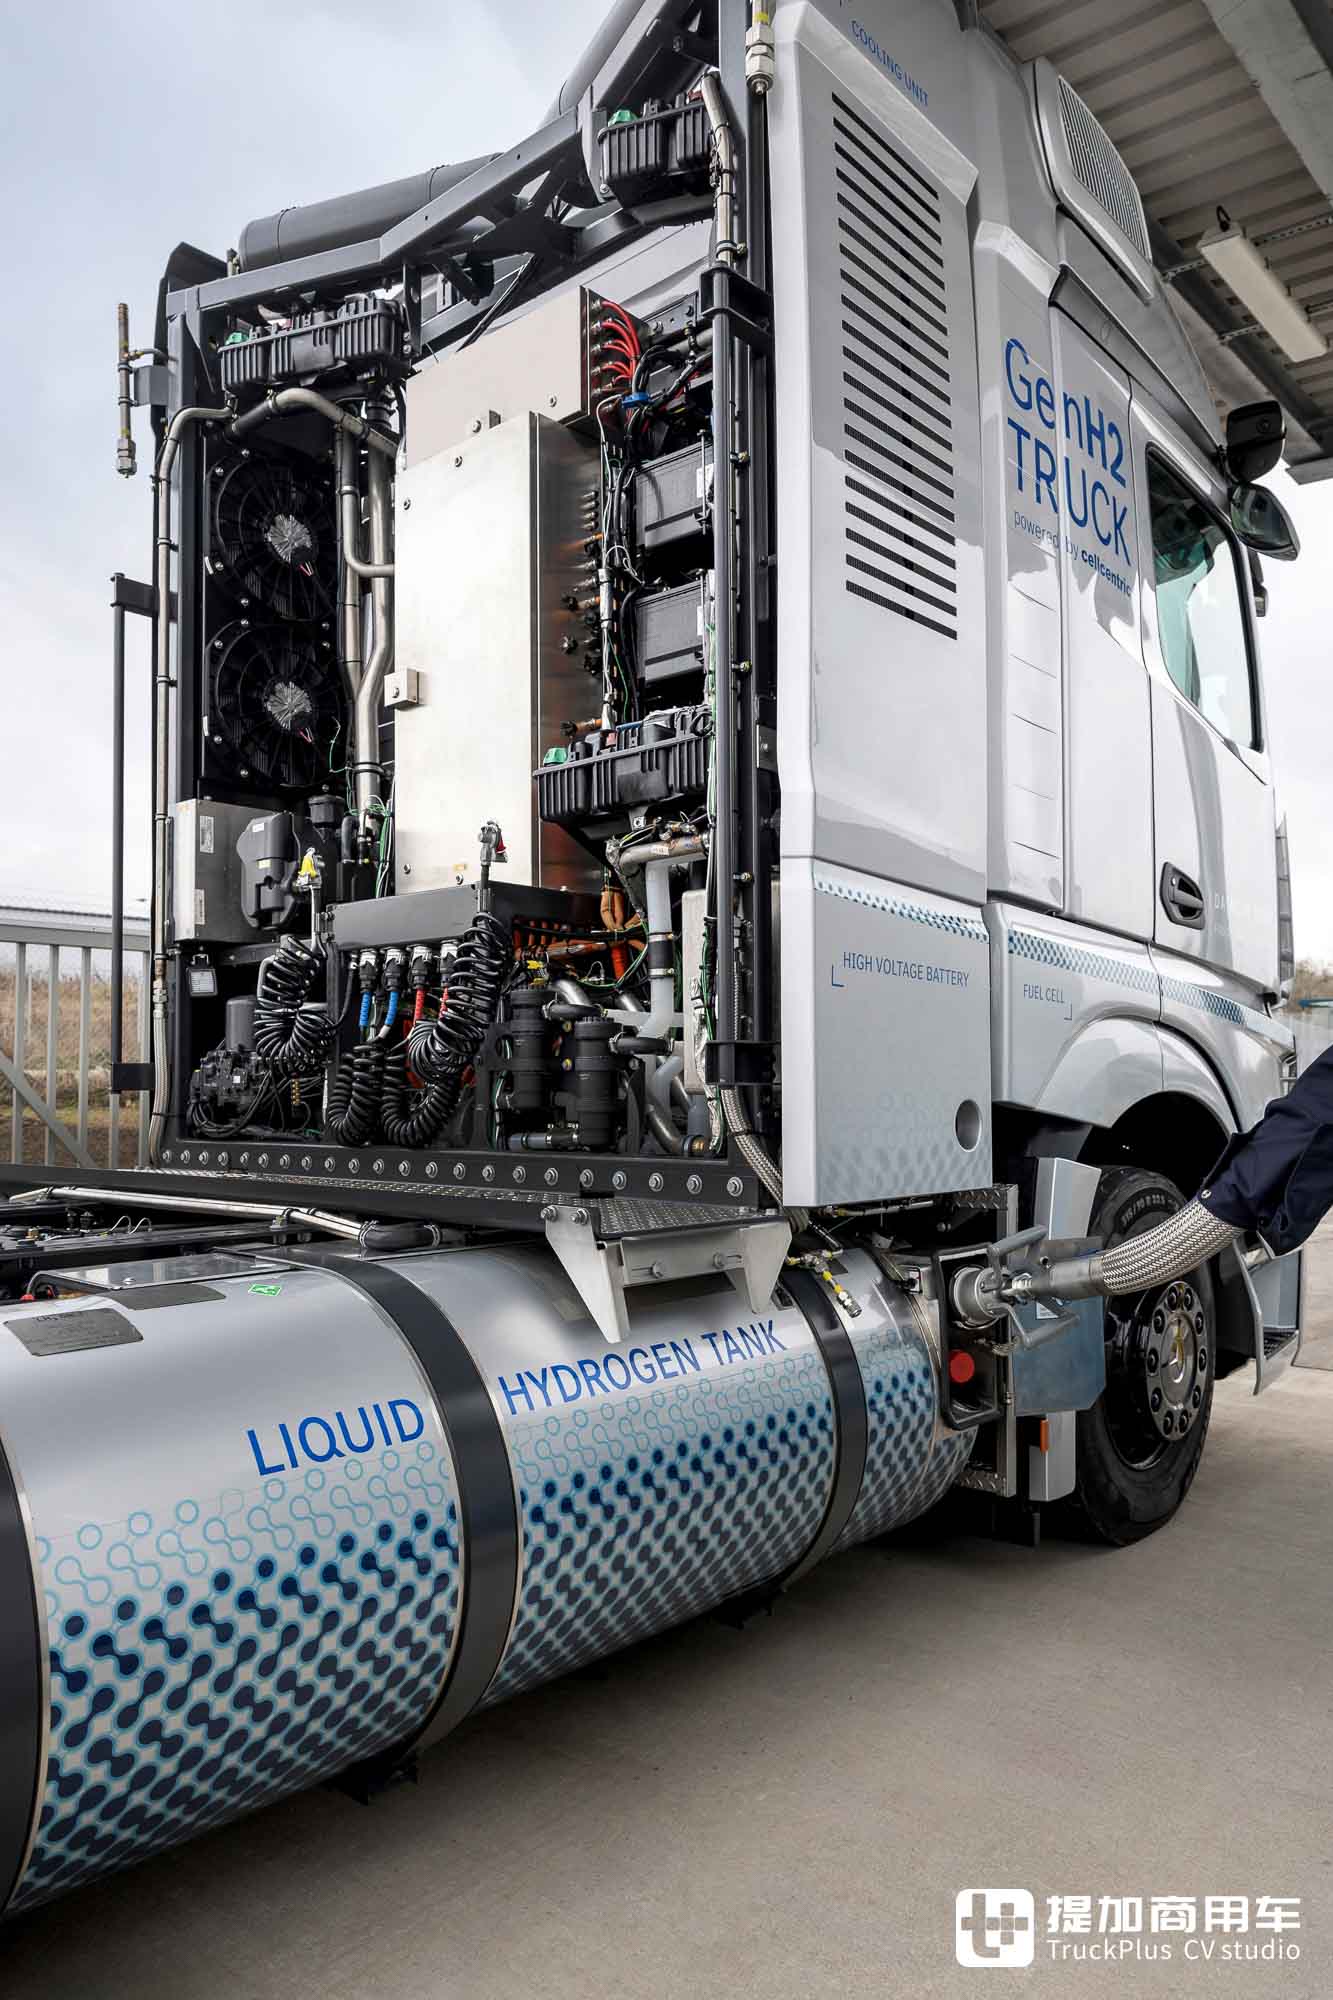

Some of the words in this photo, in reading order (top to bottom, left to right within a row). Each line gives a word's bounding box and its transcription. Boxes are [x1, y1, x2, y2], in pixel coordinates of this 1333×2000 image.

[851, 20, 903, 80] COOLING
[904, 72, 928, 106] UNIT
[1005, 338, 1126, 488] GenH2
[1007, 416, 1131, 567] TRUCK
[1014, 511, 1060, 549] powered
[1065, 536, 1079, 560] by
[1081, 549, 1132, 597] cellcentric
[843, 952, 872, 972] HIGH
[876, 958, 923, 980] VOLTAGE
[926, 966, 969, 988] BATTERY
[1023, 983, 1043, 1001] FUEL
[1045, 987, 1065, 1004] CELL
[498, 1340, 700, 1415] HYDROGEN
[701, 1319, 787, 1367] TANK
[246, 1398, 425, 1476] LIQUID
